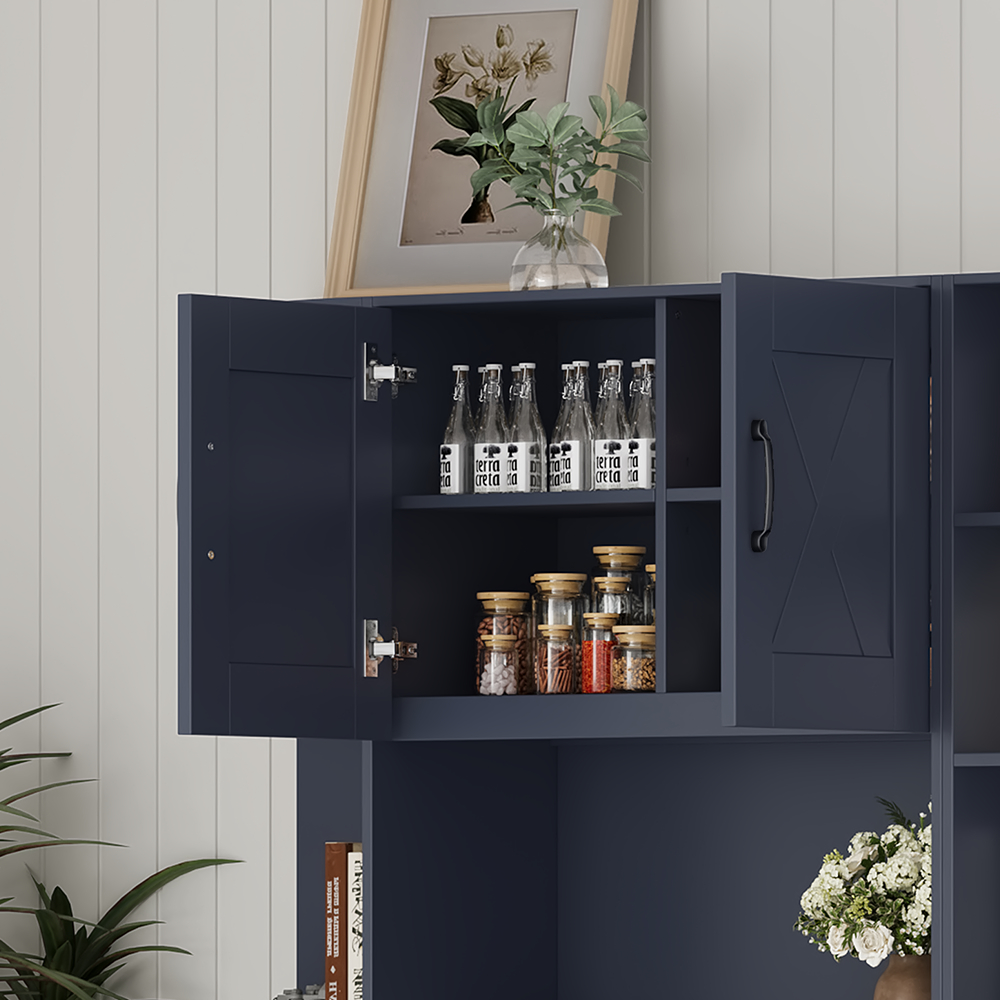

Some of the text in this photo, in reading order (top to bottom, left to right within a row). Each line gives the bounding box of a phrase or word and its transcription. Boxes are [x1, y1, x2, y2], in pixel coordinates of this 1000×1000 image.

[476, 460, 500, 472] terra
[596, 456, 620, 468] terra
[476, 474, 500, 486] creta
[596, 470, 620, 483] creta
